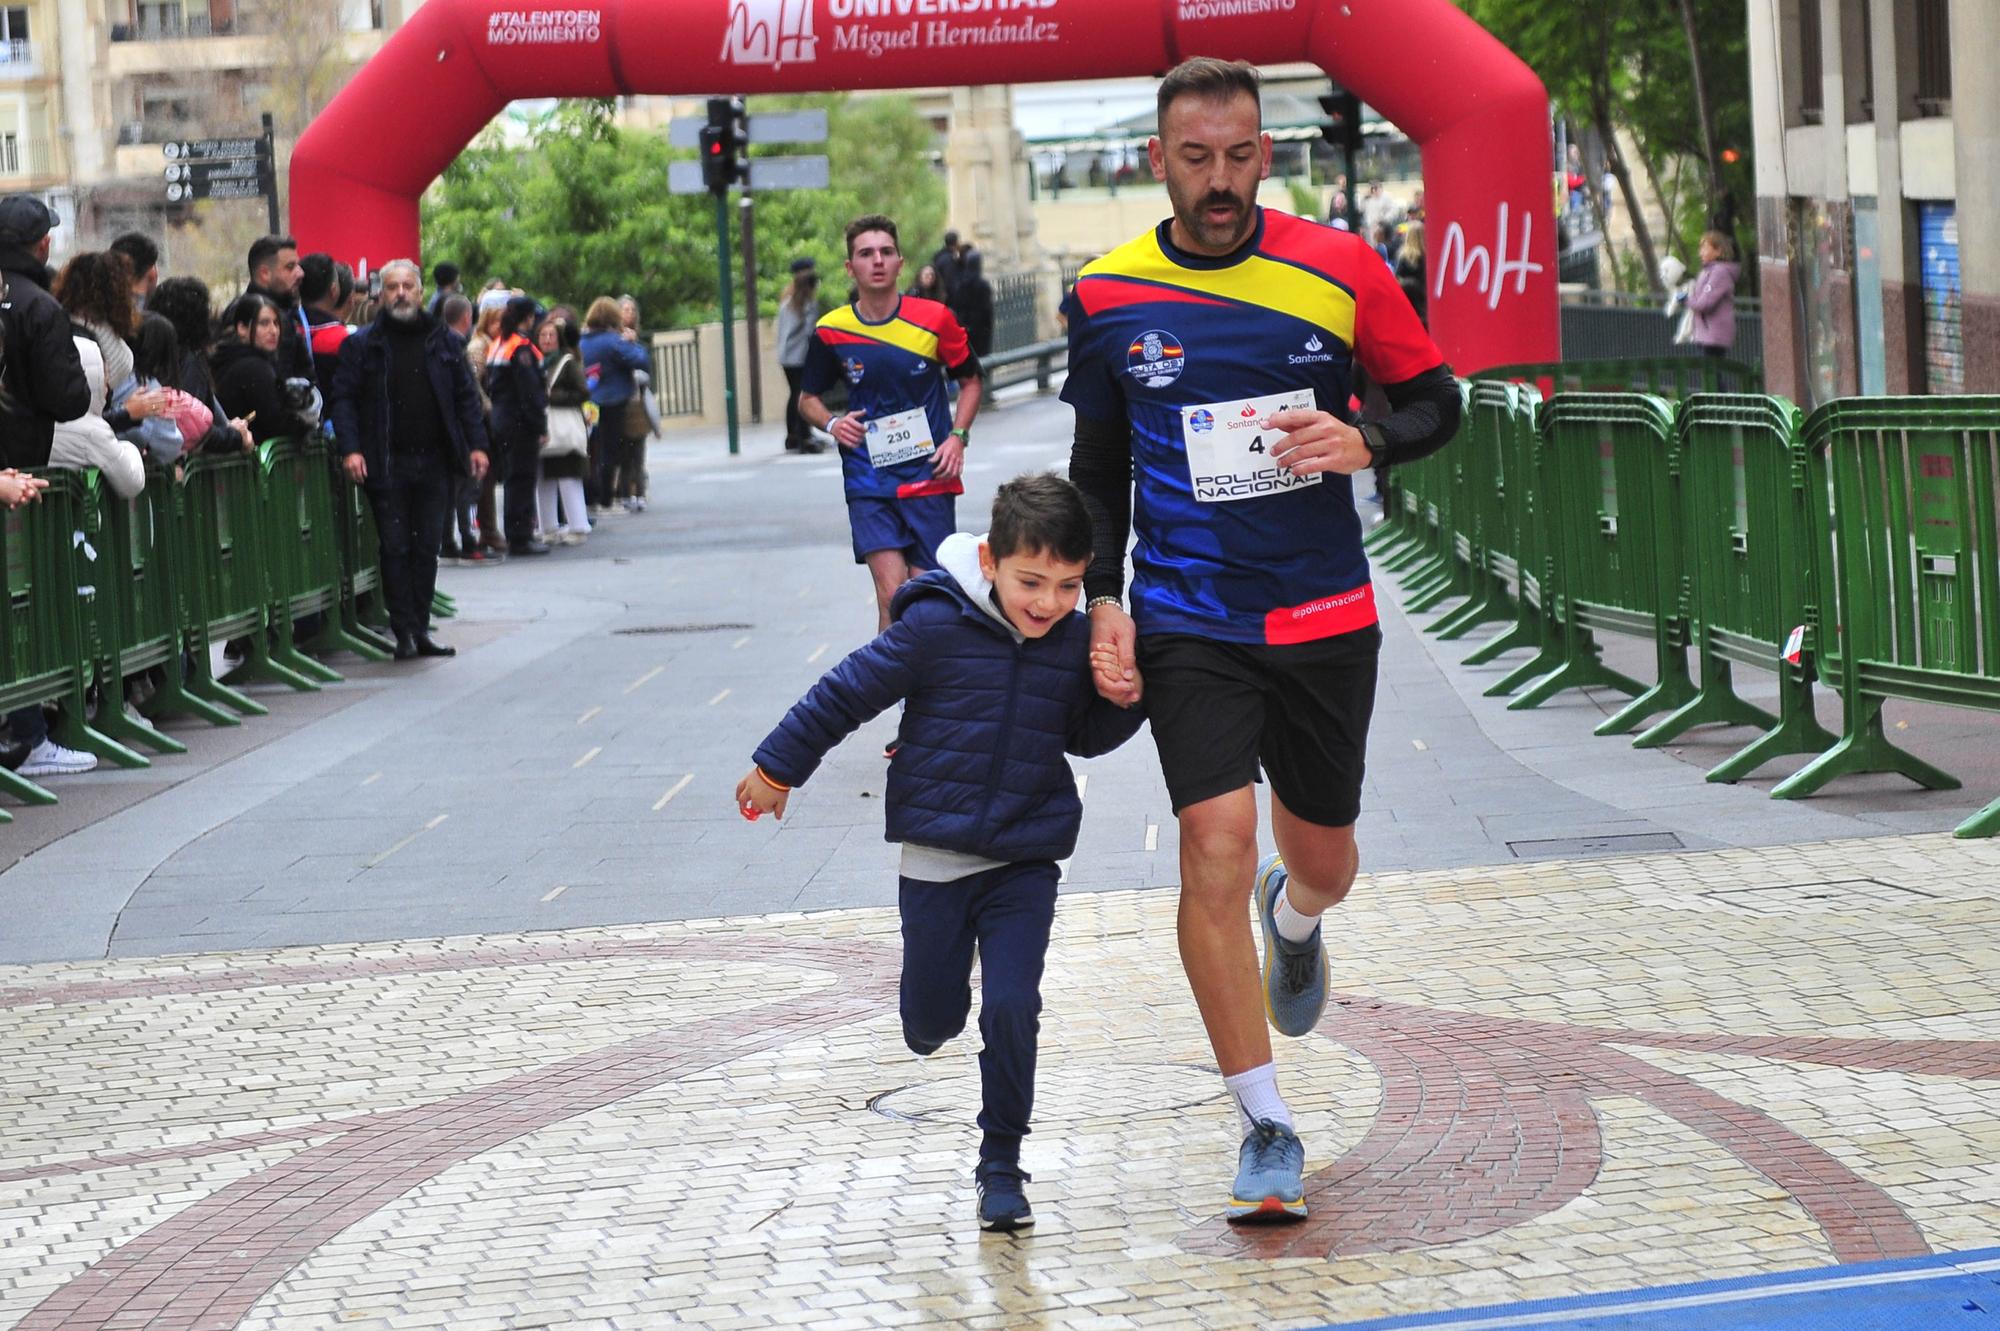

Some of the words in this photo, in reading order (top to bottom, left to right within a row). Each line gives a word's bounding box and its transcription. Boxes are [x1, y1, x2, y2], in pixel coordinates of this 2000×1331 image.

[488, 10, 601, 27] #TALENTOEN
[1178, 0, 1297, 20] MOVIMIENTO
[487, 25, 601, 45] MOVIMIENTO
[833, 21, 920, 58] Miguel
[926, 15, 1060, 48] Hernández
[1226, 417, 1264, 431] Santand
[887, 430, 911, 444] 230
[1249, 436, 1265, 454] 4
[1197, 474, 1320, 498] NACIONAL
[1292, 588, 1366, 619] @policianacional
